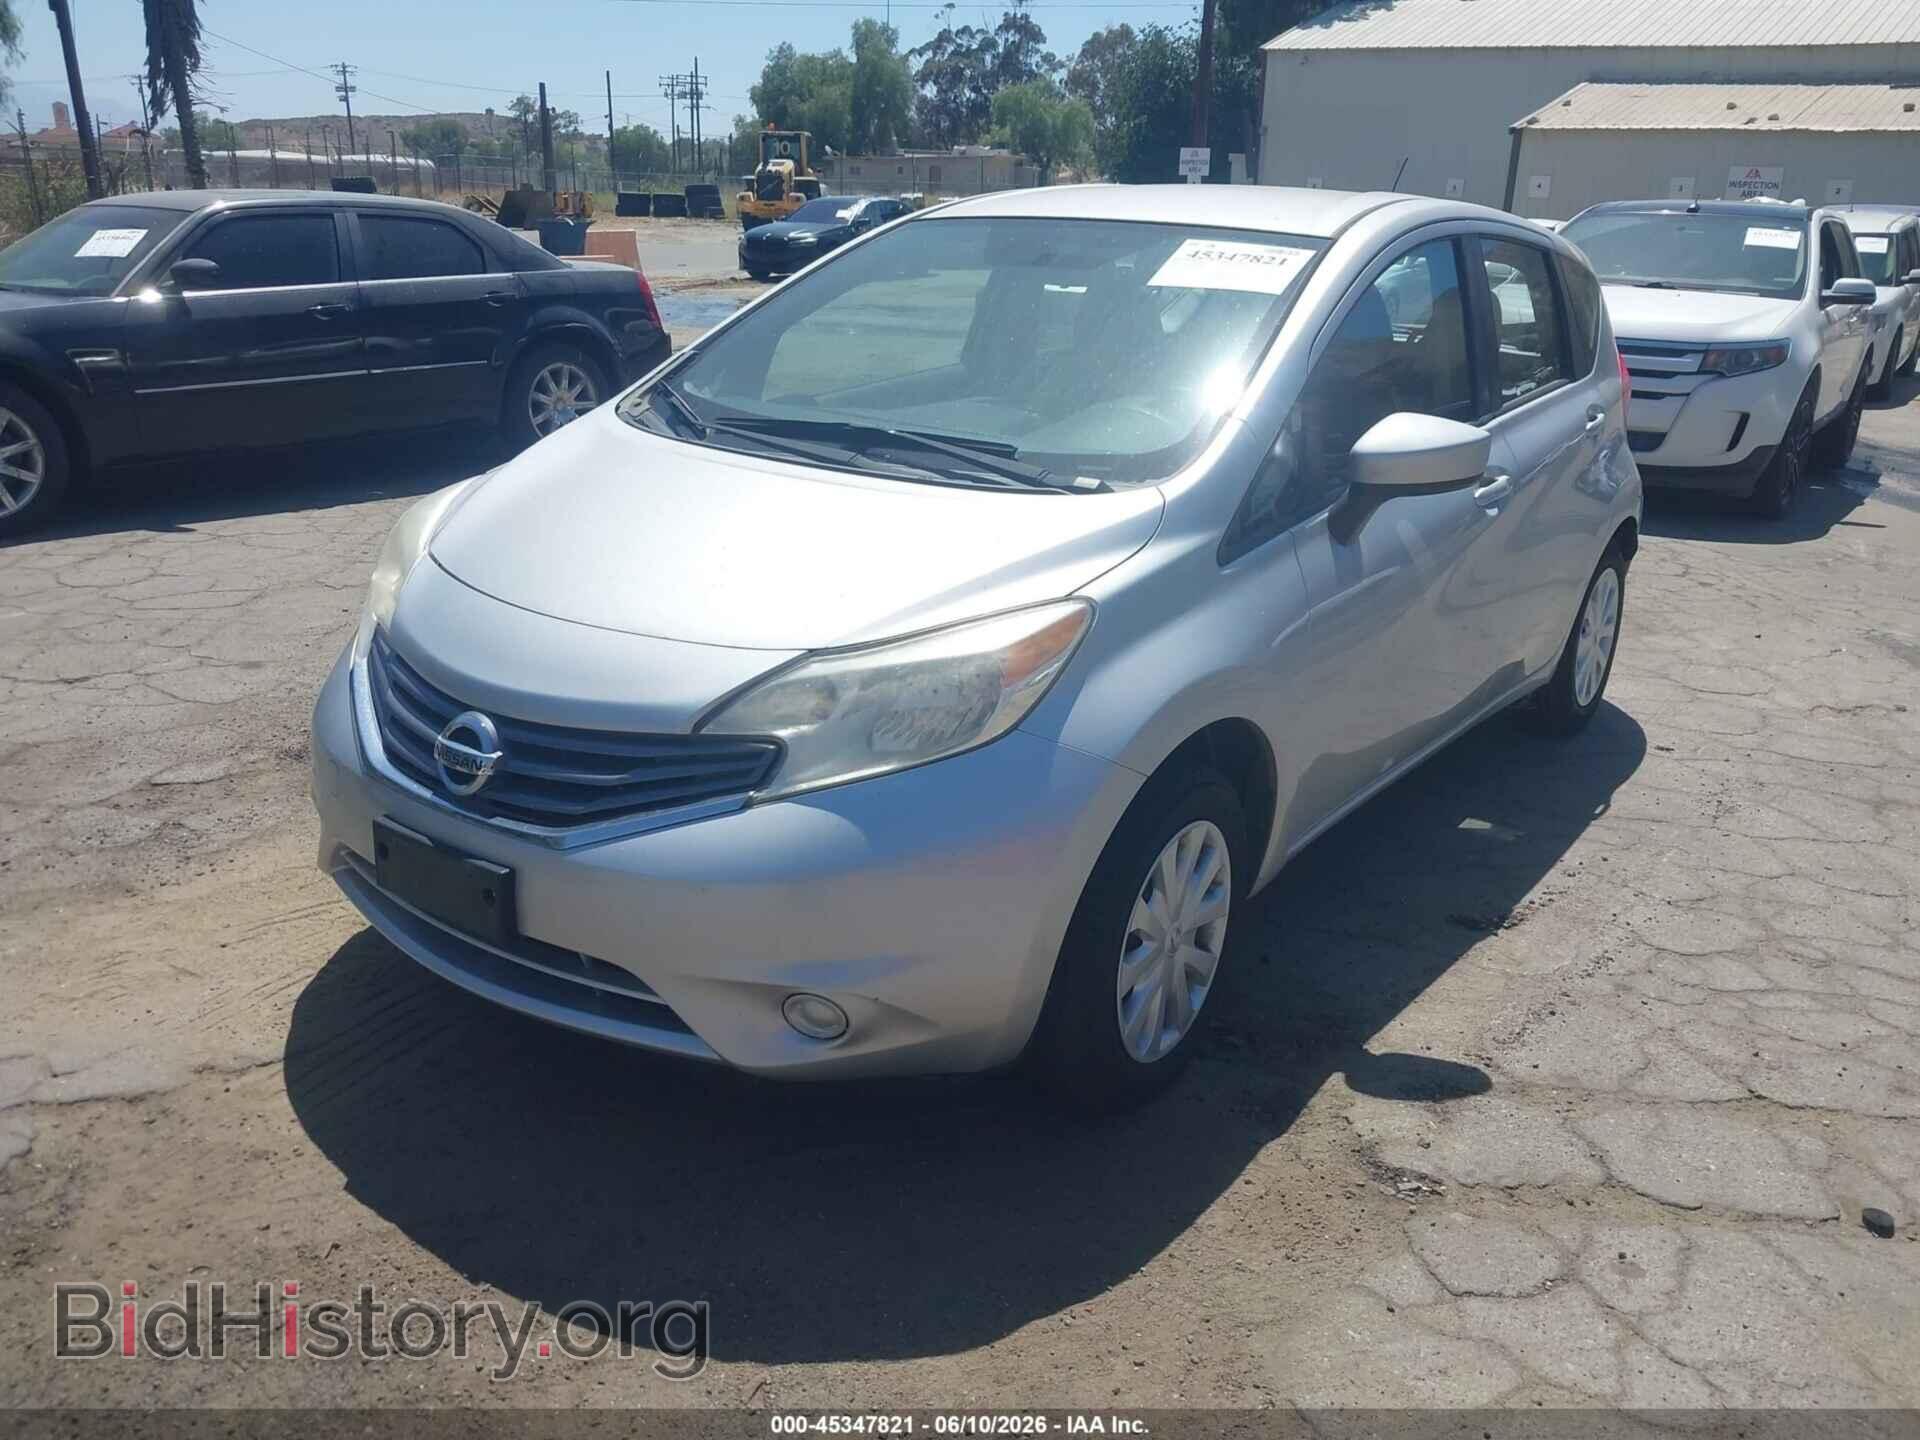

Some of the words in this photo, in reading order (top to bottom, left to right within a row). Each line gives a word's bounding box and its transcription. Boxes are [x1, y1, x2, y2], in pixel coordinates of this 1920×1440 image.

[1728, 180, 1779, 190] INSPECTION
[1186, 250, 1289, 265] 45347821
[433, 740, 483, 775] NISSAN
